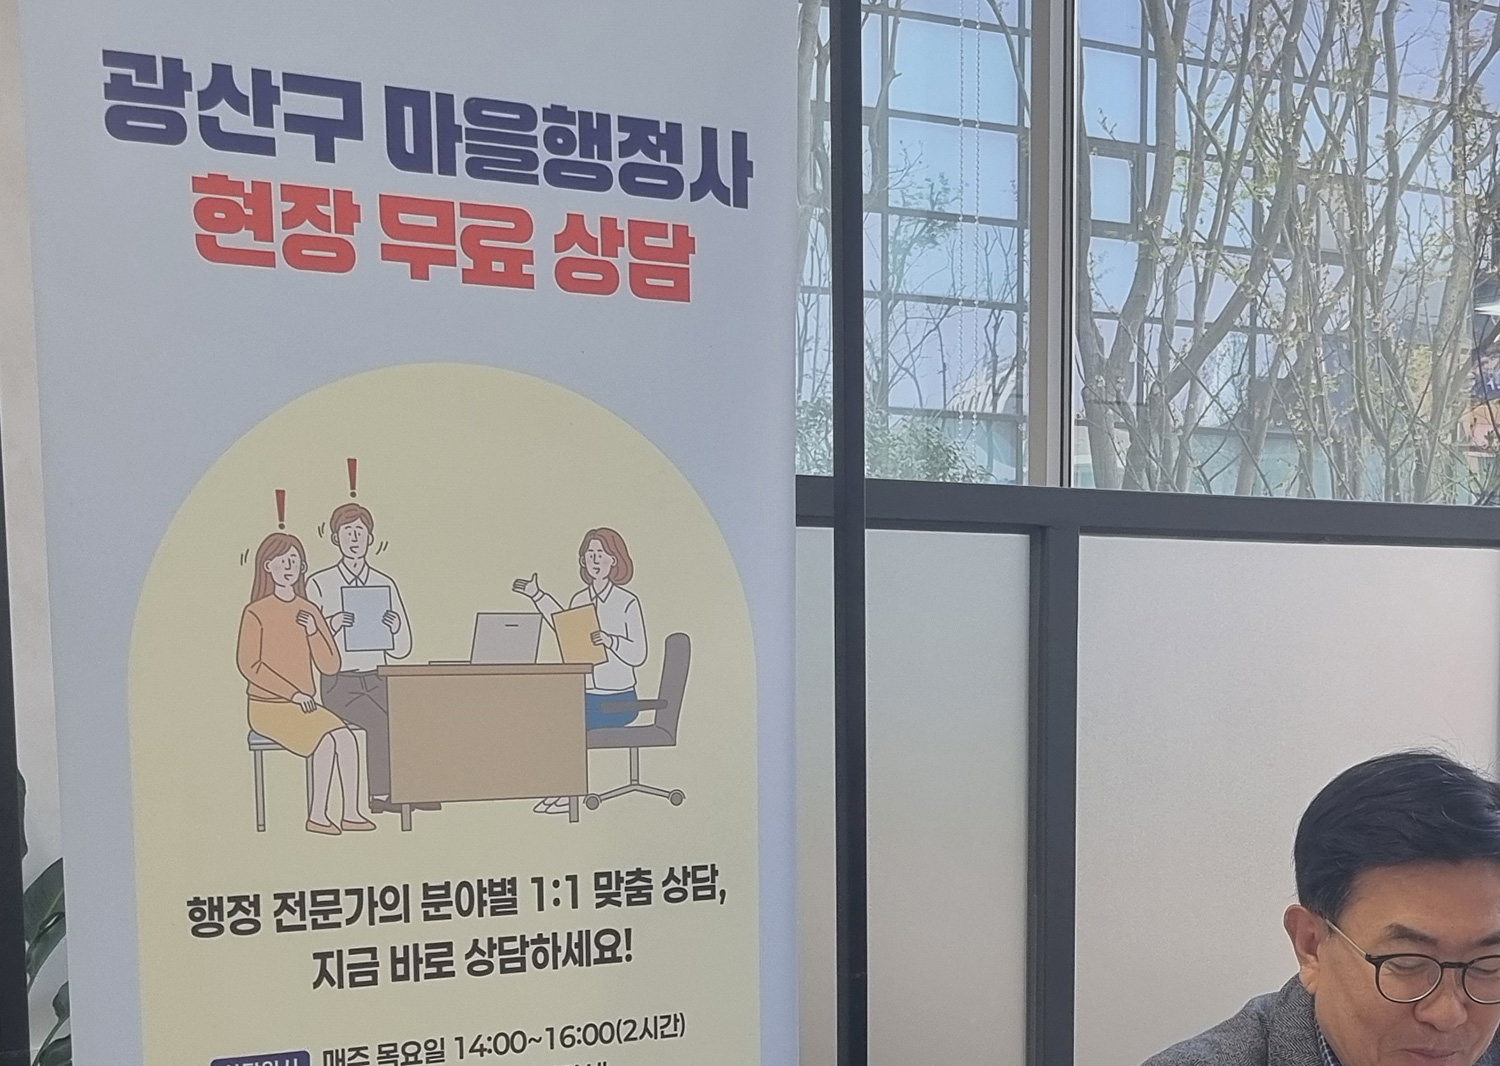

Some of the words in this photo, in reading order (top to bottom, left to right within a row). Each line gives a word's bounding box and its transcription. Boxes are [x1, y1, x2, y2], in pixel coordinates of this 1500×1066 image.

[102, 48, 364, 165] 광산구
[384, 85, 754, 210] 마을행정사
[191, 173, 362, 274] 현장
[379, 194, 535, 290] 무료
[554, 212, 695, 303] 상담
[187, 894, 262, 939] 행정
[273, 883, 410, 933] 전문가의
[420, 876, 518, 921] 분야별
[530, 874, 579, 913] 1:1
[592, 867, 654, 907] 맞춤
[661, 863, 728, 905] 상담,
[312, 944, 379, 990] 지금
[389, 940, 456, 985] 바로
[464, 927, 633, 977] 상담하세요!
[453, 1012, 686, 1061] 14:00~16:00(2시간)
